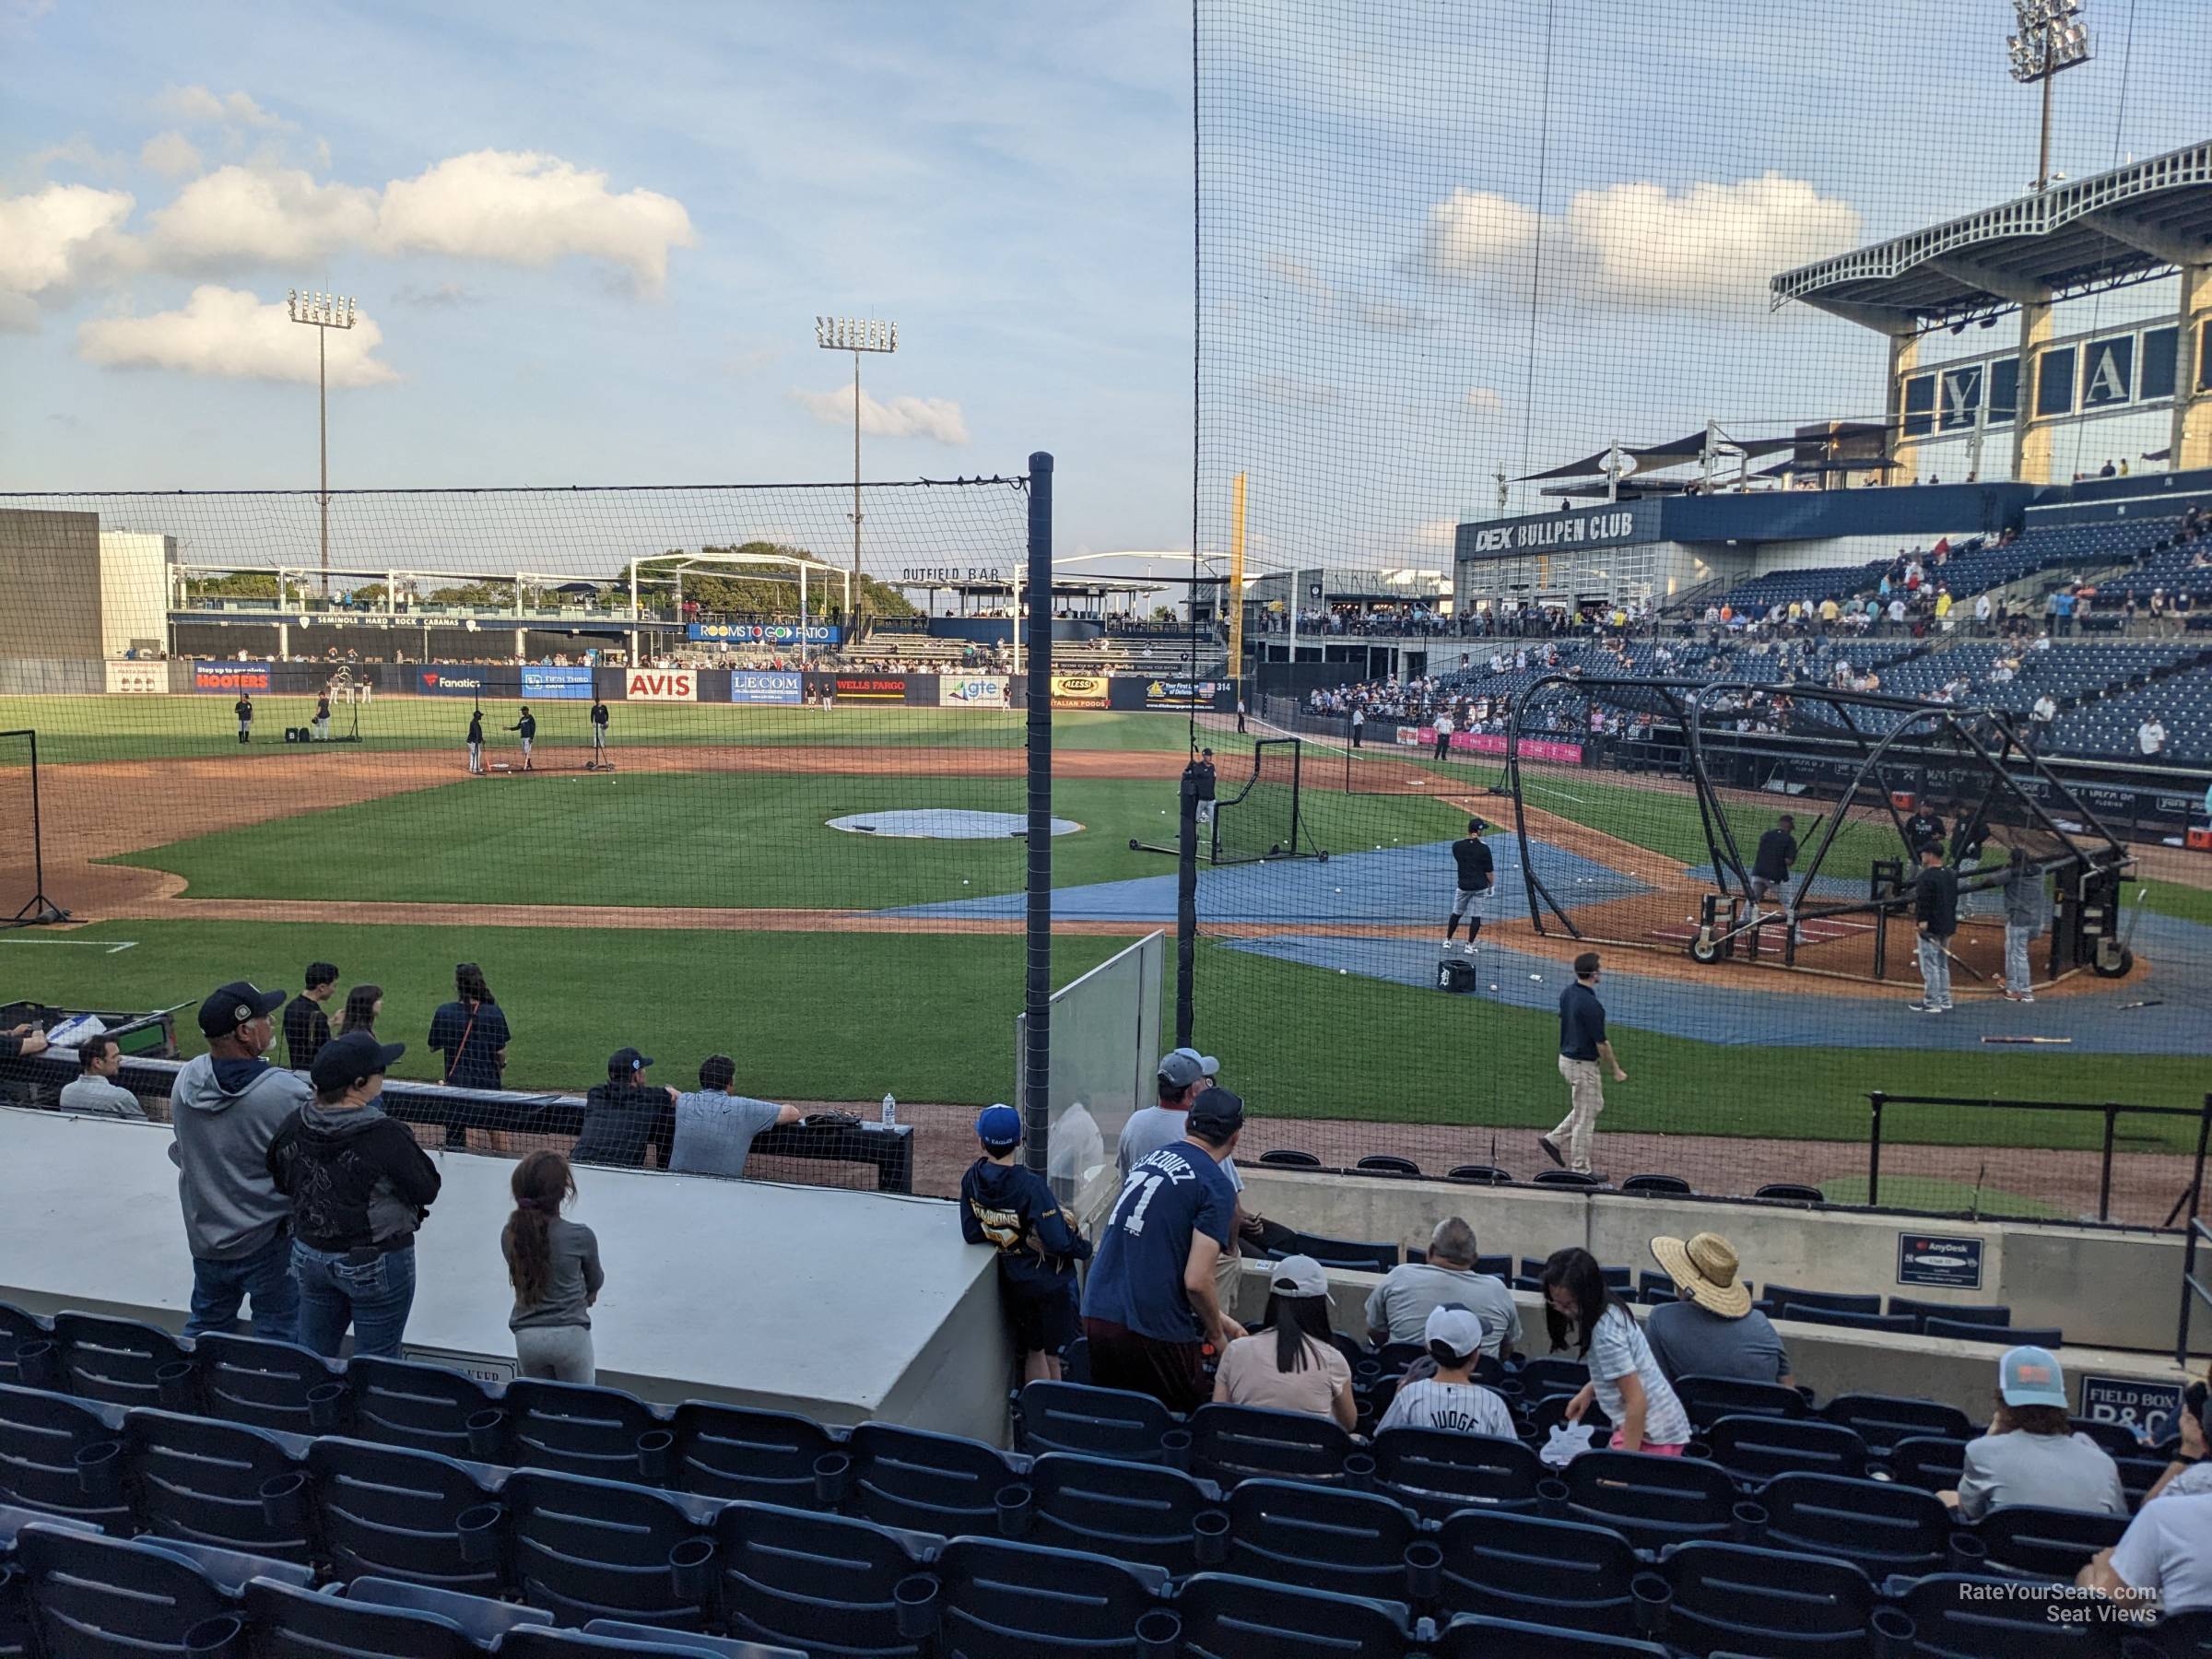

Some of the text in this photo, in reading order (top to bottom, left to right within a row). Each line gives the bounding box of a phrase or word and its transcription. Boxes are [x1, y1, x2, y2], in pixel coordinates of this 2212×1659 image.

[2085, 346, 2128, 404] A
[1945, 370, 1980, 425] Y
[1476, 512, 1633, 552] DEX BULLPEN CLUB
[903, 568, 999, 582] OUTFIELD BAR
[700, 625, 829, 639] ROOMS TO GO PATIO
[196, 675, 267, 688] HOOTERS
[440, 677, 480, 688] Fanatics
[629, 675, 691, 697] AVIS
[837, 681, 906, 690] WELLS FARGO
[1065, 680, 1091, 688] ALESSI
[1217, 683, 1230, 691] 314
[1108, 1171, 1164, 1232] 71
[1928, 1242, 1968, 1253] AnyDesk
[2090, 1388, 2175, 1408] FIELD BOX
